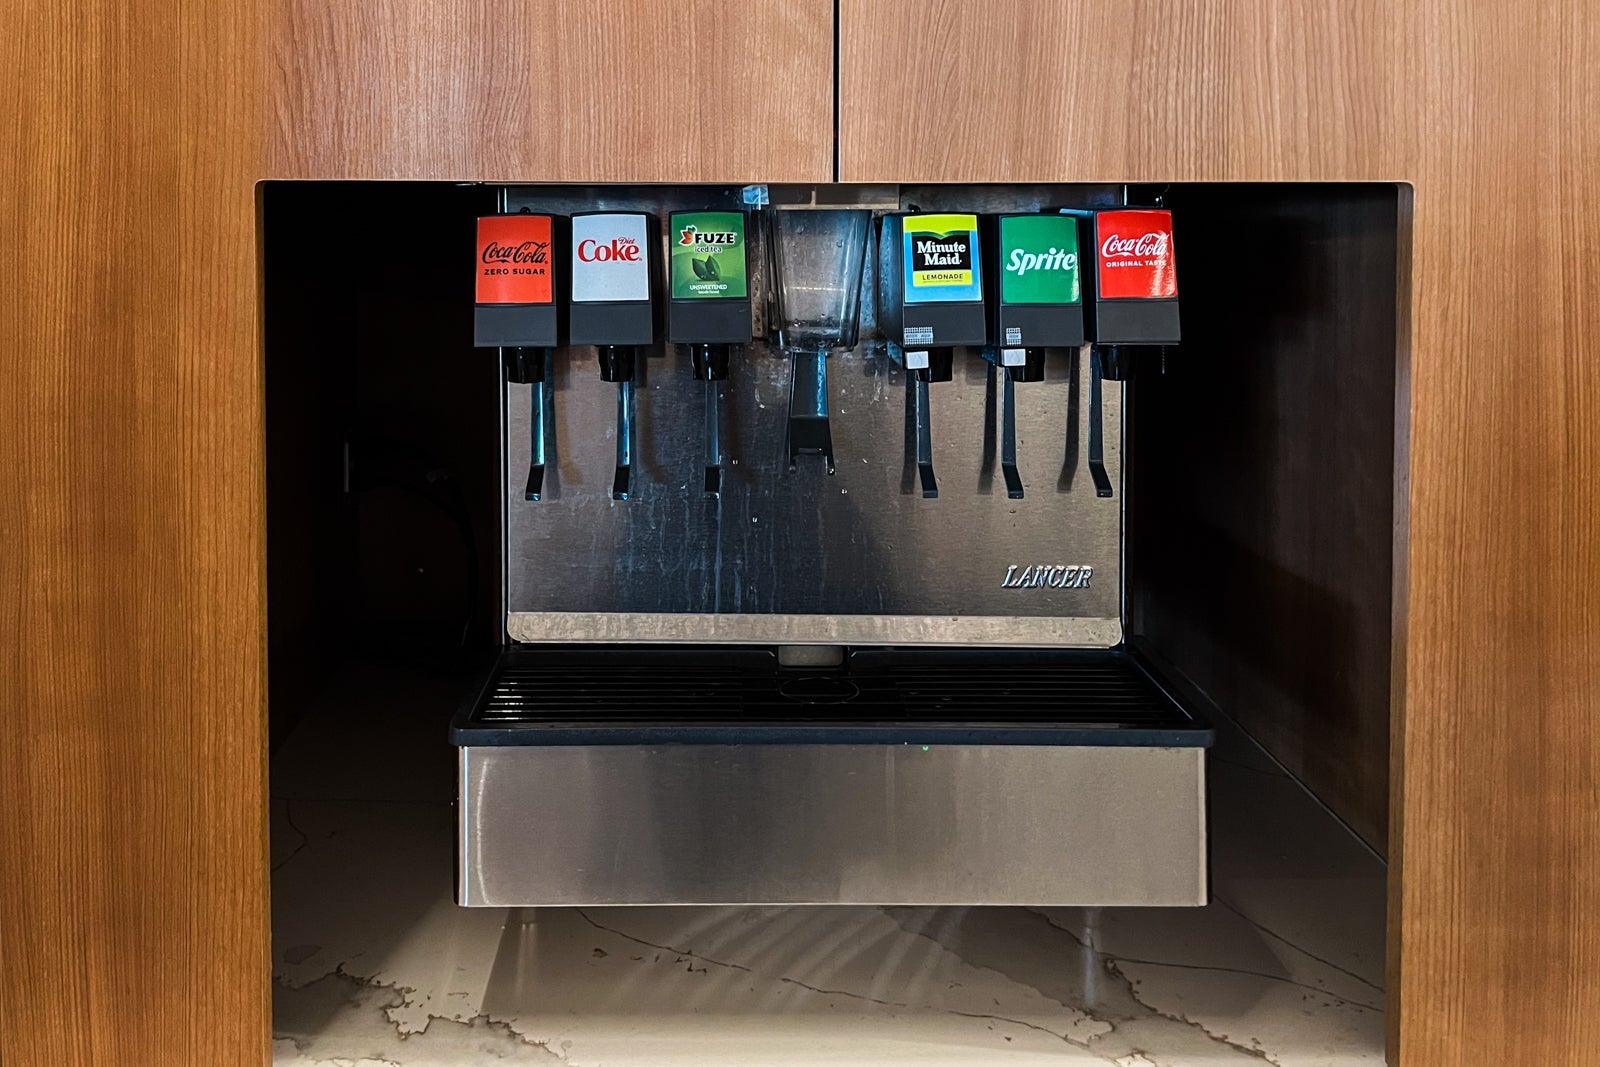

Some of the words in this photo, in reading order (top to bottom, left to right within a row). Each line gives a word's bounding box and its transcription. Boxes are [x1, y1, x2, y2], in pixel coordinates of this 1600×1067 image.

[618, 237, 635, 245] Diet
[694, 233, 735, 244] FUZE
[917, 241, 966, 253] Minute
[577, 239, 640, 262] Coke
[1006, 248, 1075, 275] Sprite
[1001, 565, 1093, 588] LANCER
